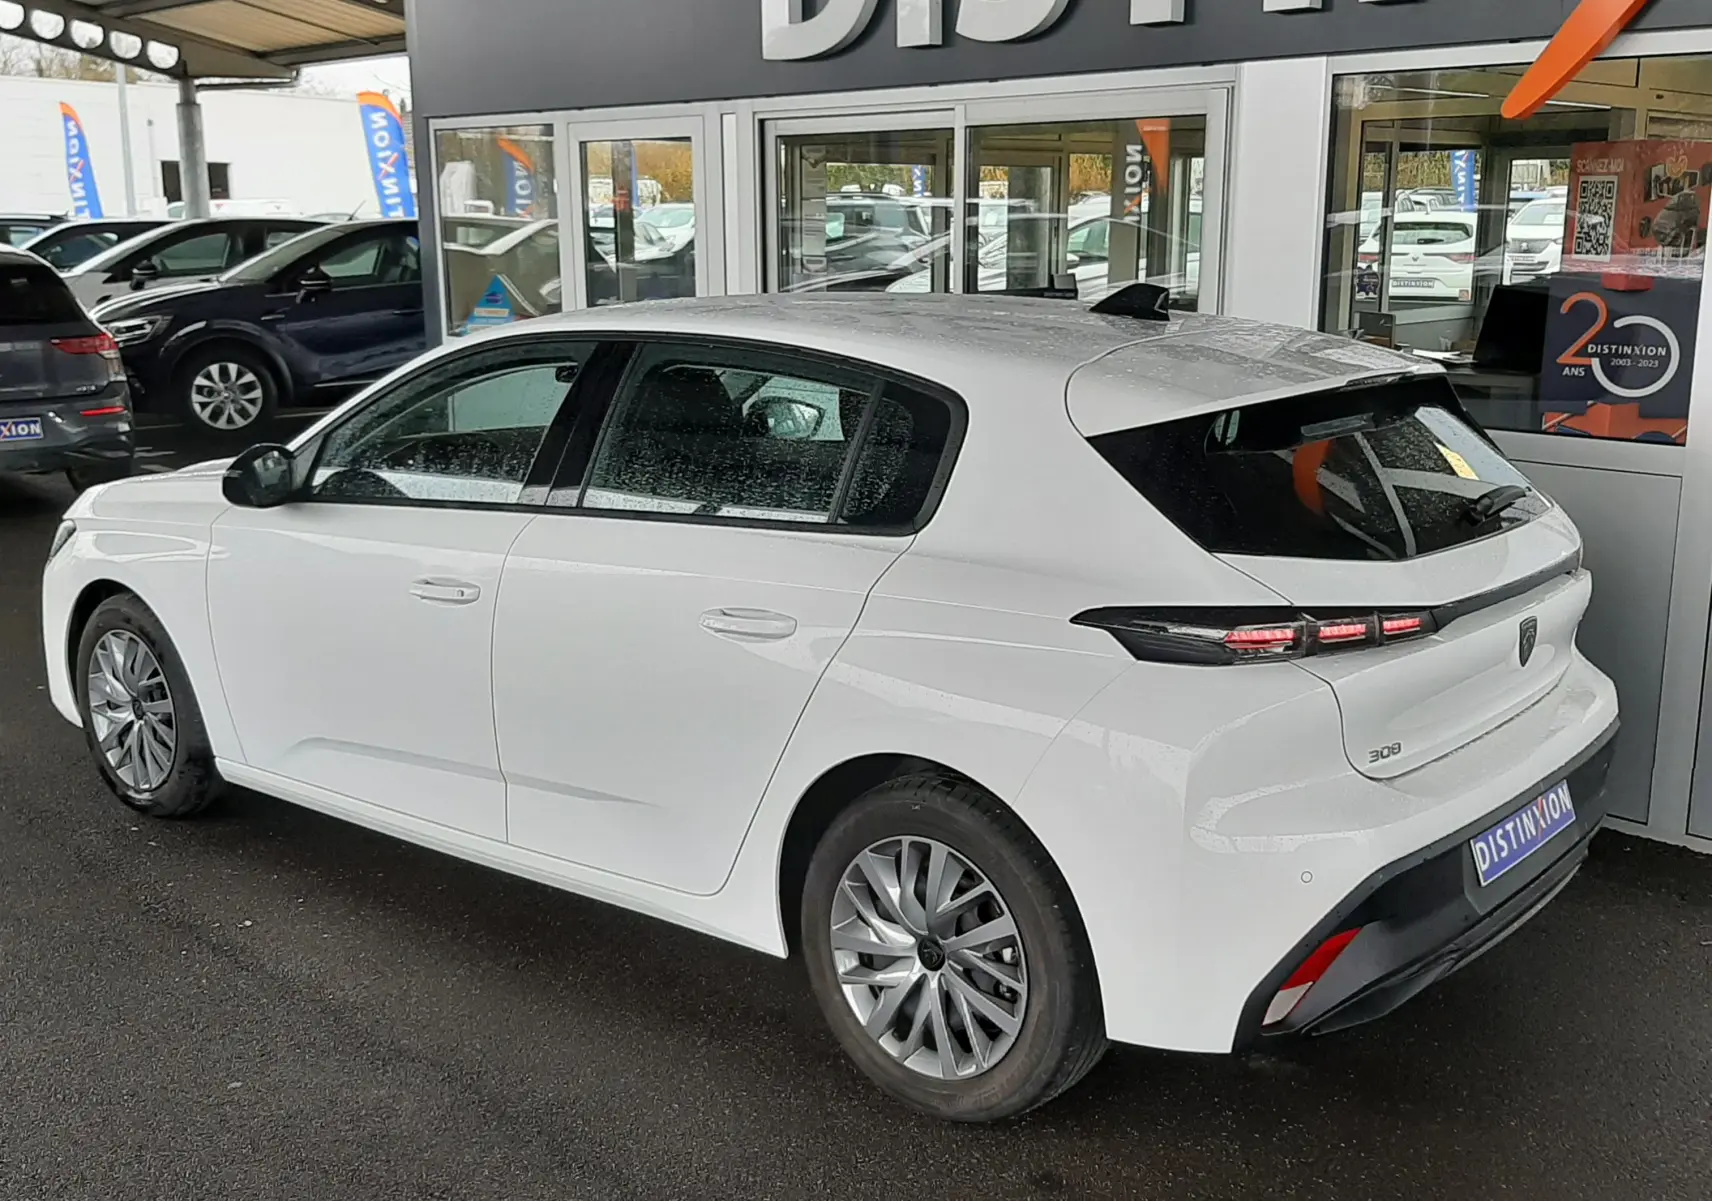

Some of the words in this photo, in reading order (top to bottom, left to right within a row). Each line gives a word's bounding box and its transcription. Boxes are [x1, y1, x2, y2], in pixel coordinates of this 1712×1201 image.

[1587, 343, 1667, 357] DISTINXION
[1562, 366, 1585, 377] ANS
[1368, 742, 1402, 764] 308
[1475, 784, 1572, 872] DISTINXION
